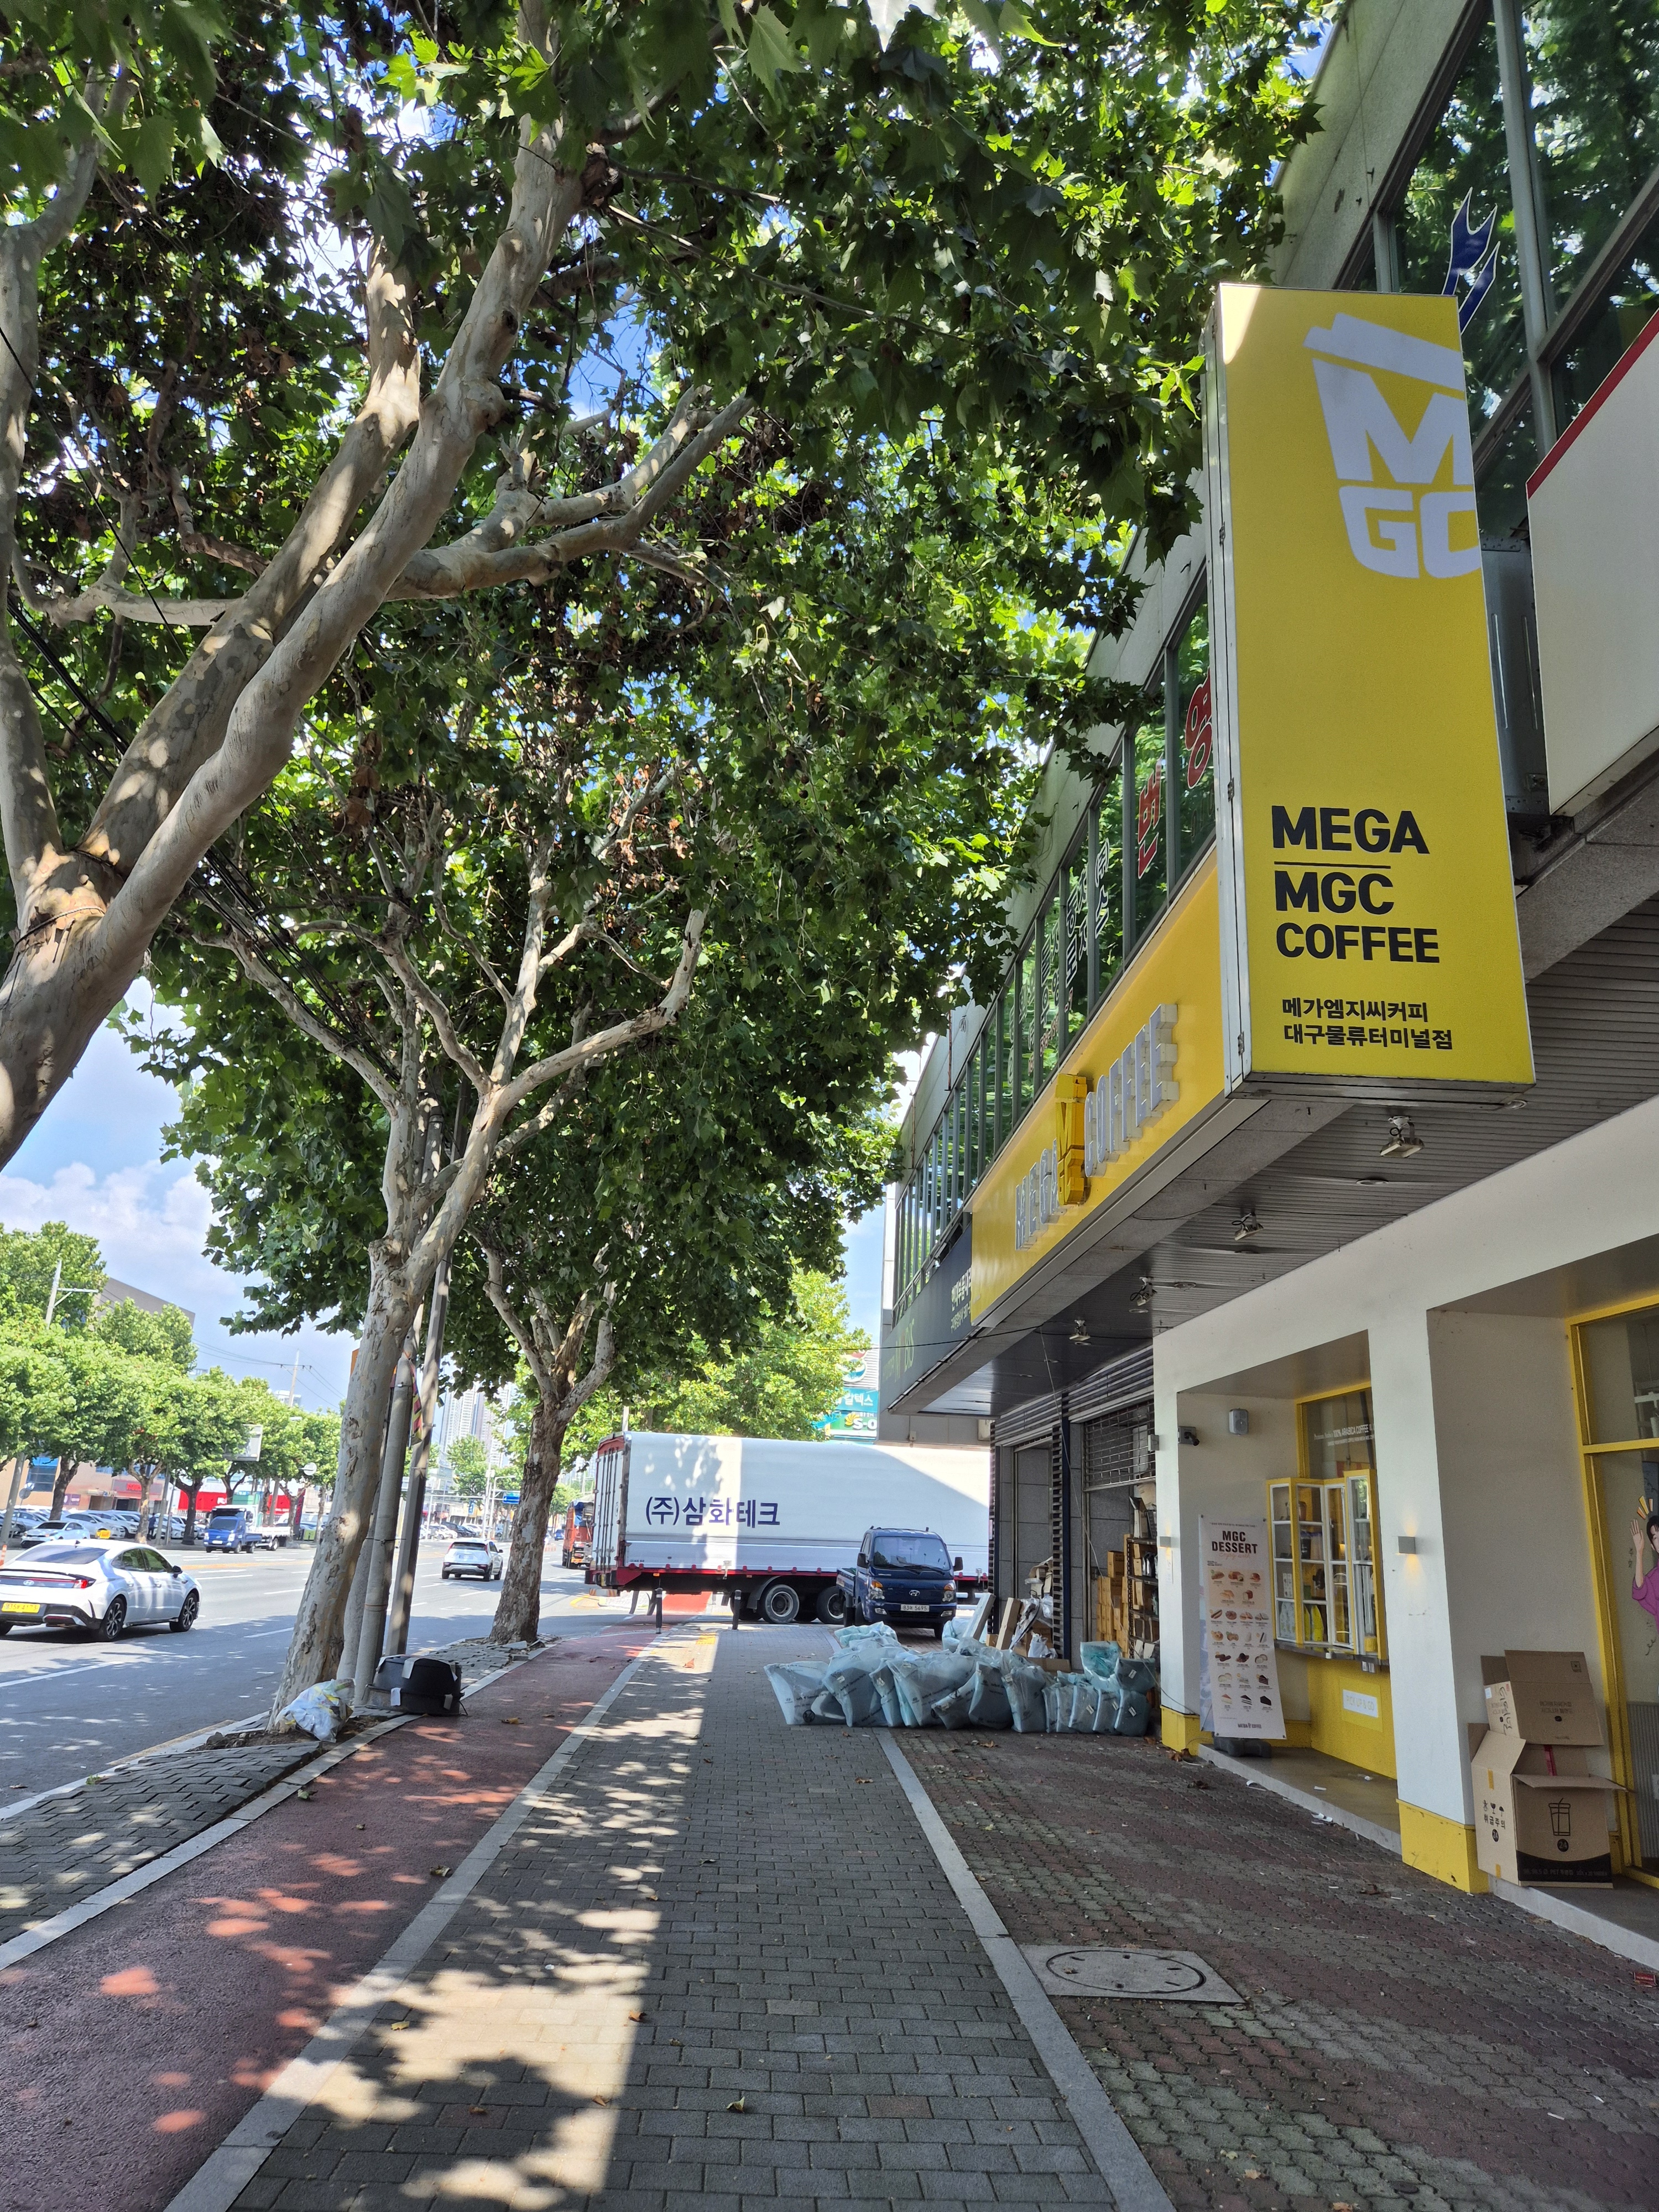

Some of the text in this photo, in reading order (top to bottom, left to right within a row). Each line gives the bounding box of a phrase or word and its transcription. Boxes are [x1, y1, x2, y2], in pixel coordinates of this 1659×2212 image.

[1271, 805, 1430, 854] MEGA
[1274, 870, 1394, 915] MGC
[1276, 922, 1439, 963] COFFEE
[1282, 997, 1428, 1022] 메가엠지씨커피
[1284, 1024, 1453, 1050] 대구물류터미널점
[1084, 1004, 1178, 1177] COFFEE
[646, 1496, 780, 1528] (주)삼화테크
[1212, 1541, 1258, 1553] DESSERT
[1222, 1531, 1246, 1542] MGC
[1484, 1813, 1505, 1829] 취급주의
[1558, 1841, 1568, 1849] 24
